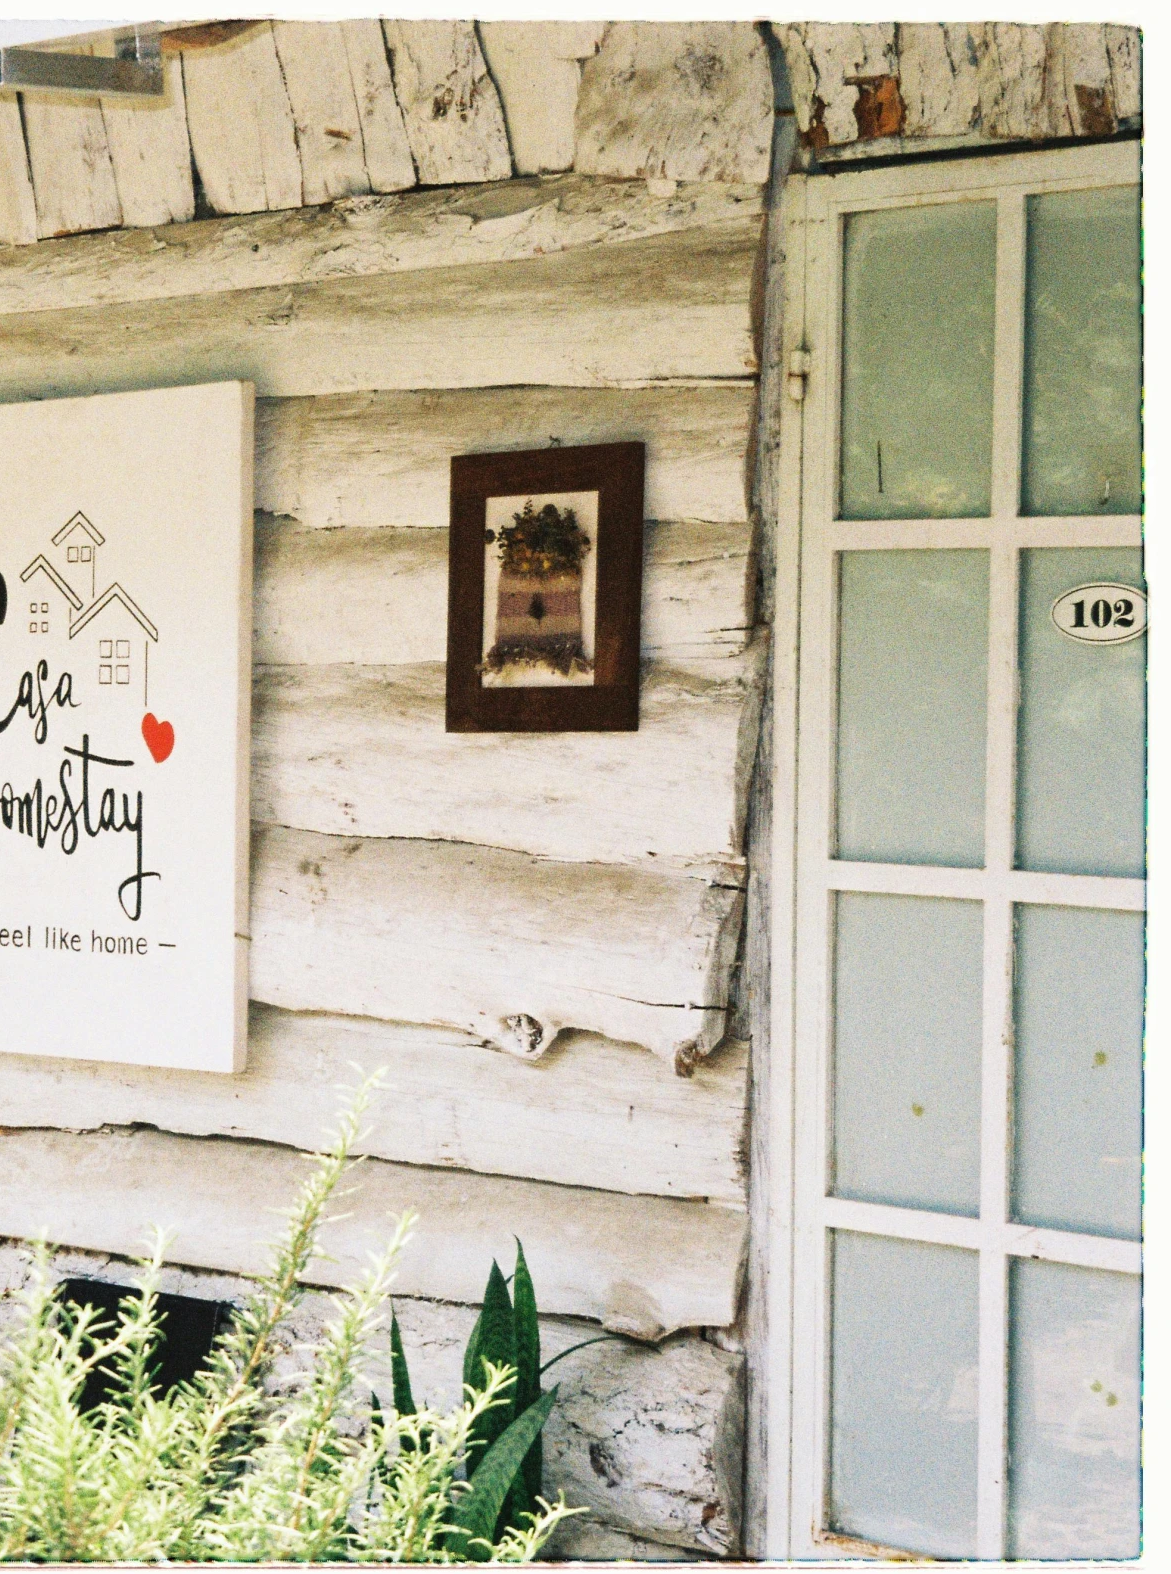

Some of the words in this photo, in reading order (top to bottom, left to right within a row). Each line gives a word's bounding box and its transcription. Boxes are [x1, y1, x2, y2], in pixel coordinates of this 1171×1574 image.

[1070, 599, 1135, 628] 102
[45, 926, 82, 952] like
[91, 929, 149, 955] home
